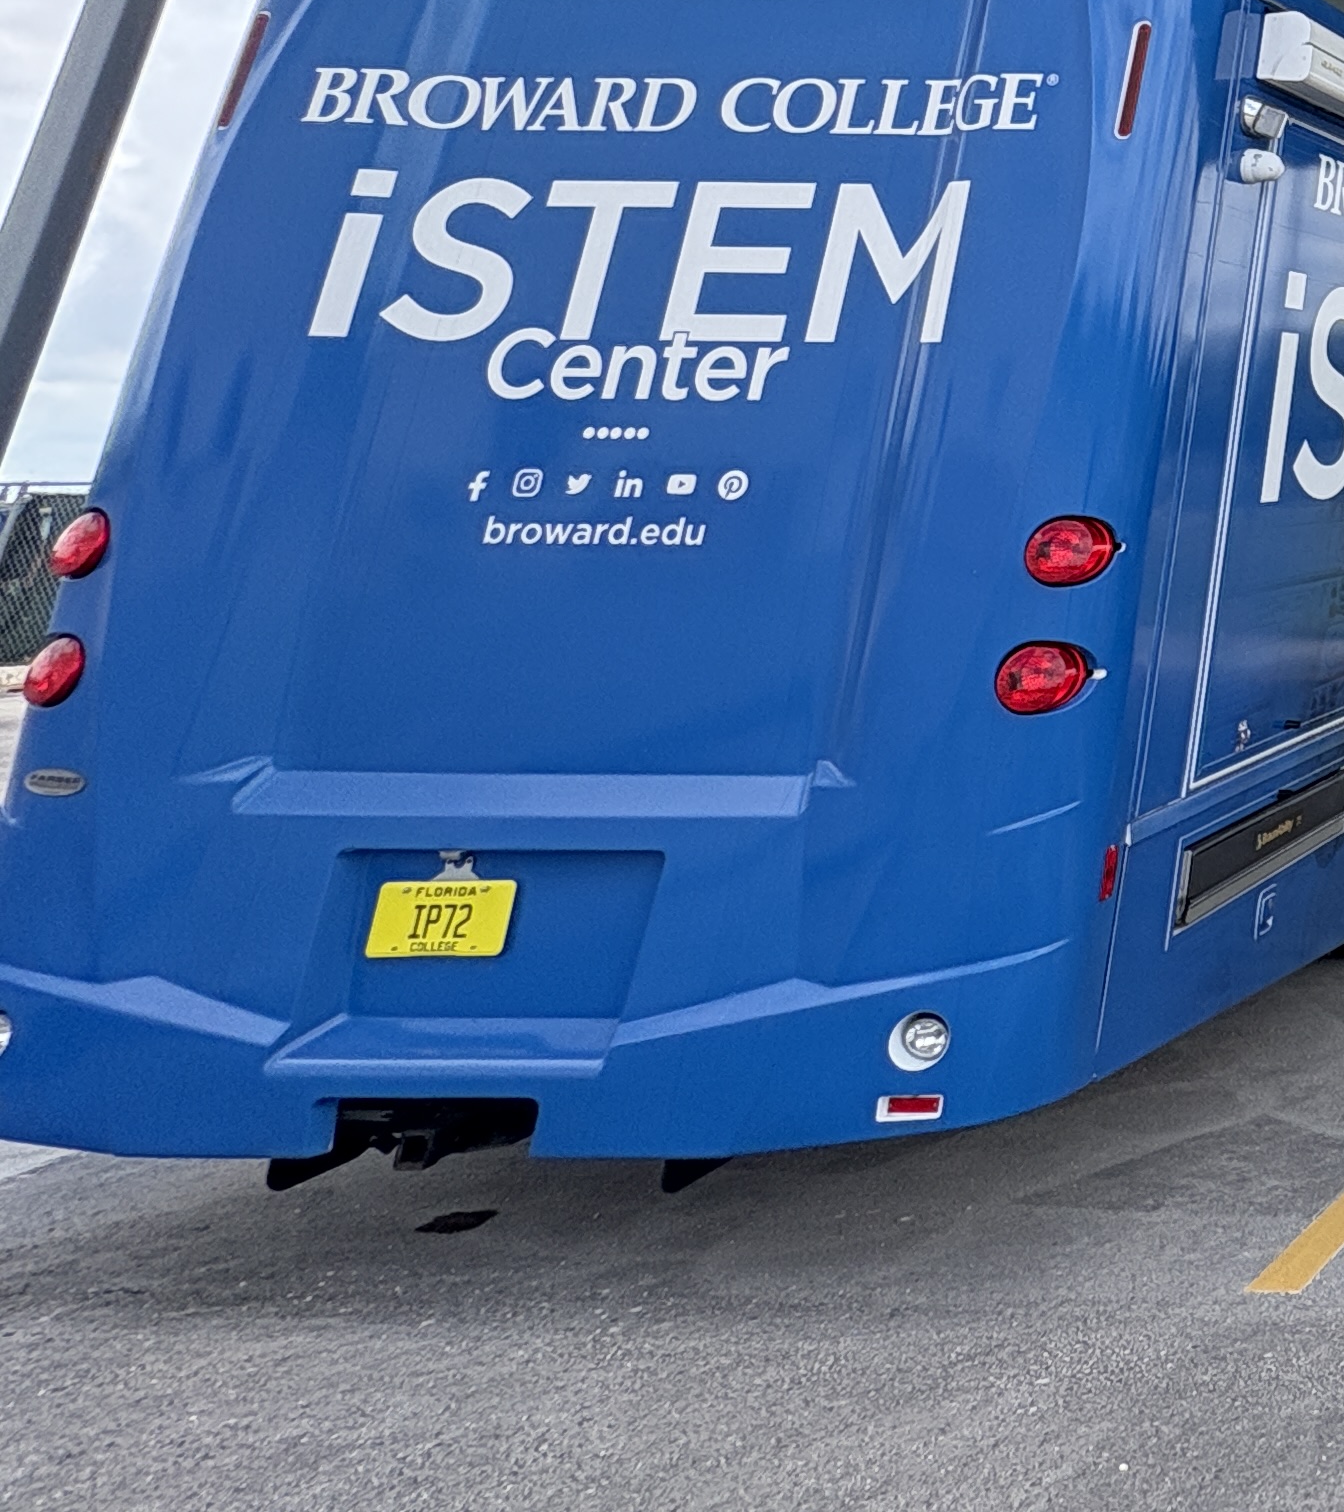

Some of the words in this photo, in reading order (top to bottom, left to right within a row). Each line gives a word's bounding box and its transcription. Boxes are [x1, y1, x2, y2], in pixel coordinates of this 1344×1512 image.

[300, 67, 698, 133] BROWARD
[308, 168, 972, 344] iSTEM
[486, 326, 790, 402] Center
[481, 515, 707, 547] broward.edu
[415, 886, 477, 898] FLORIDA
[407, 903, 474, 940] IP72
[410, 940, 460, 953] COLLEGE
